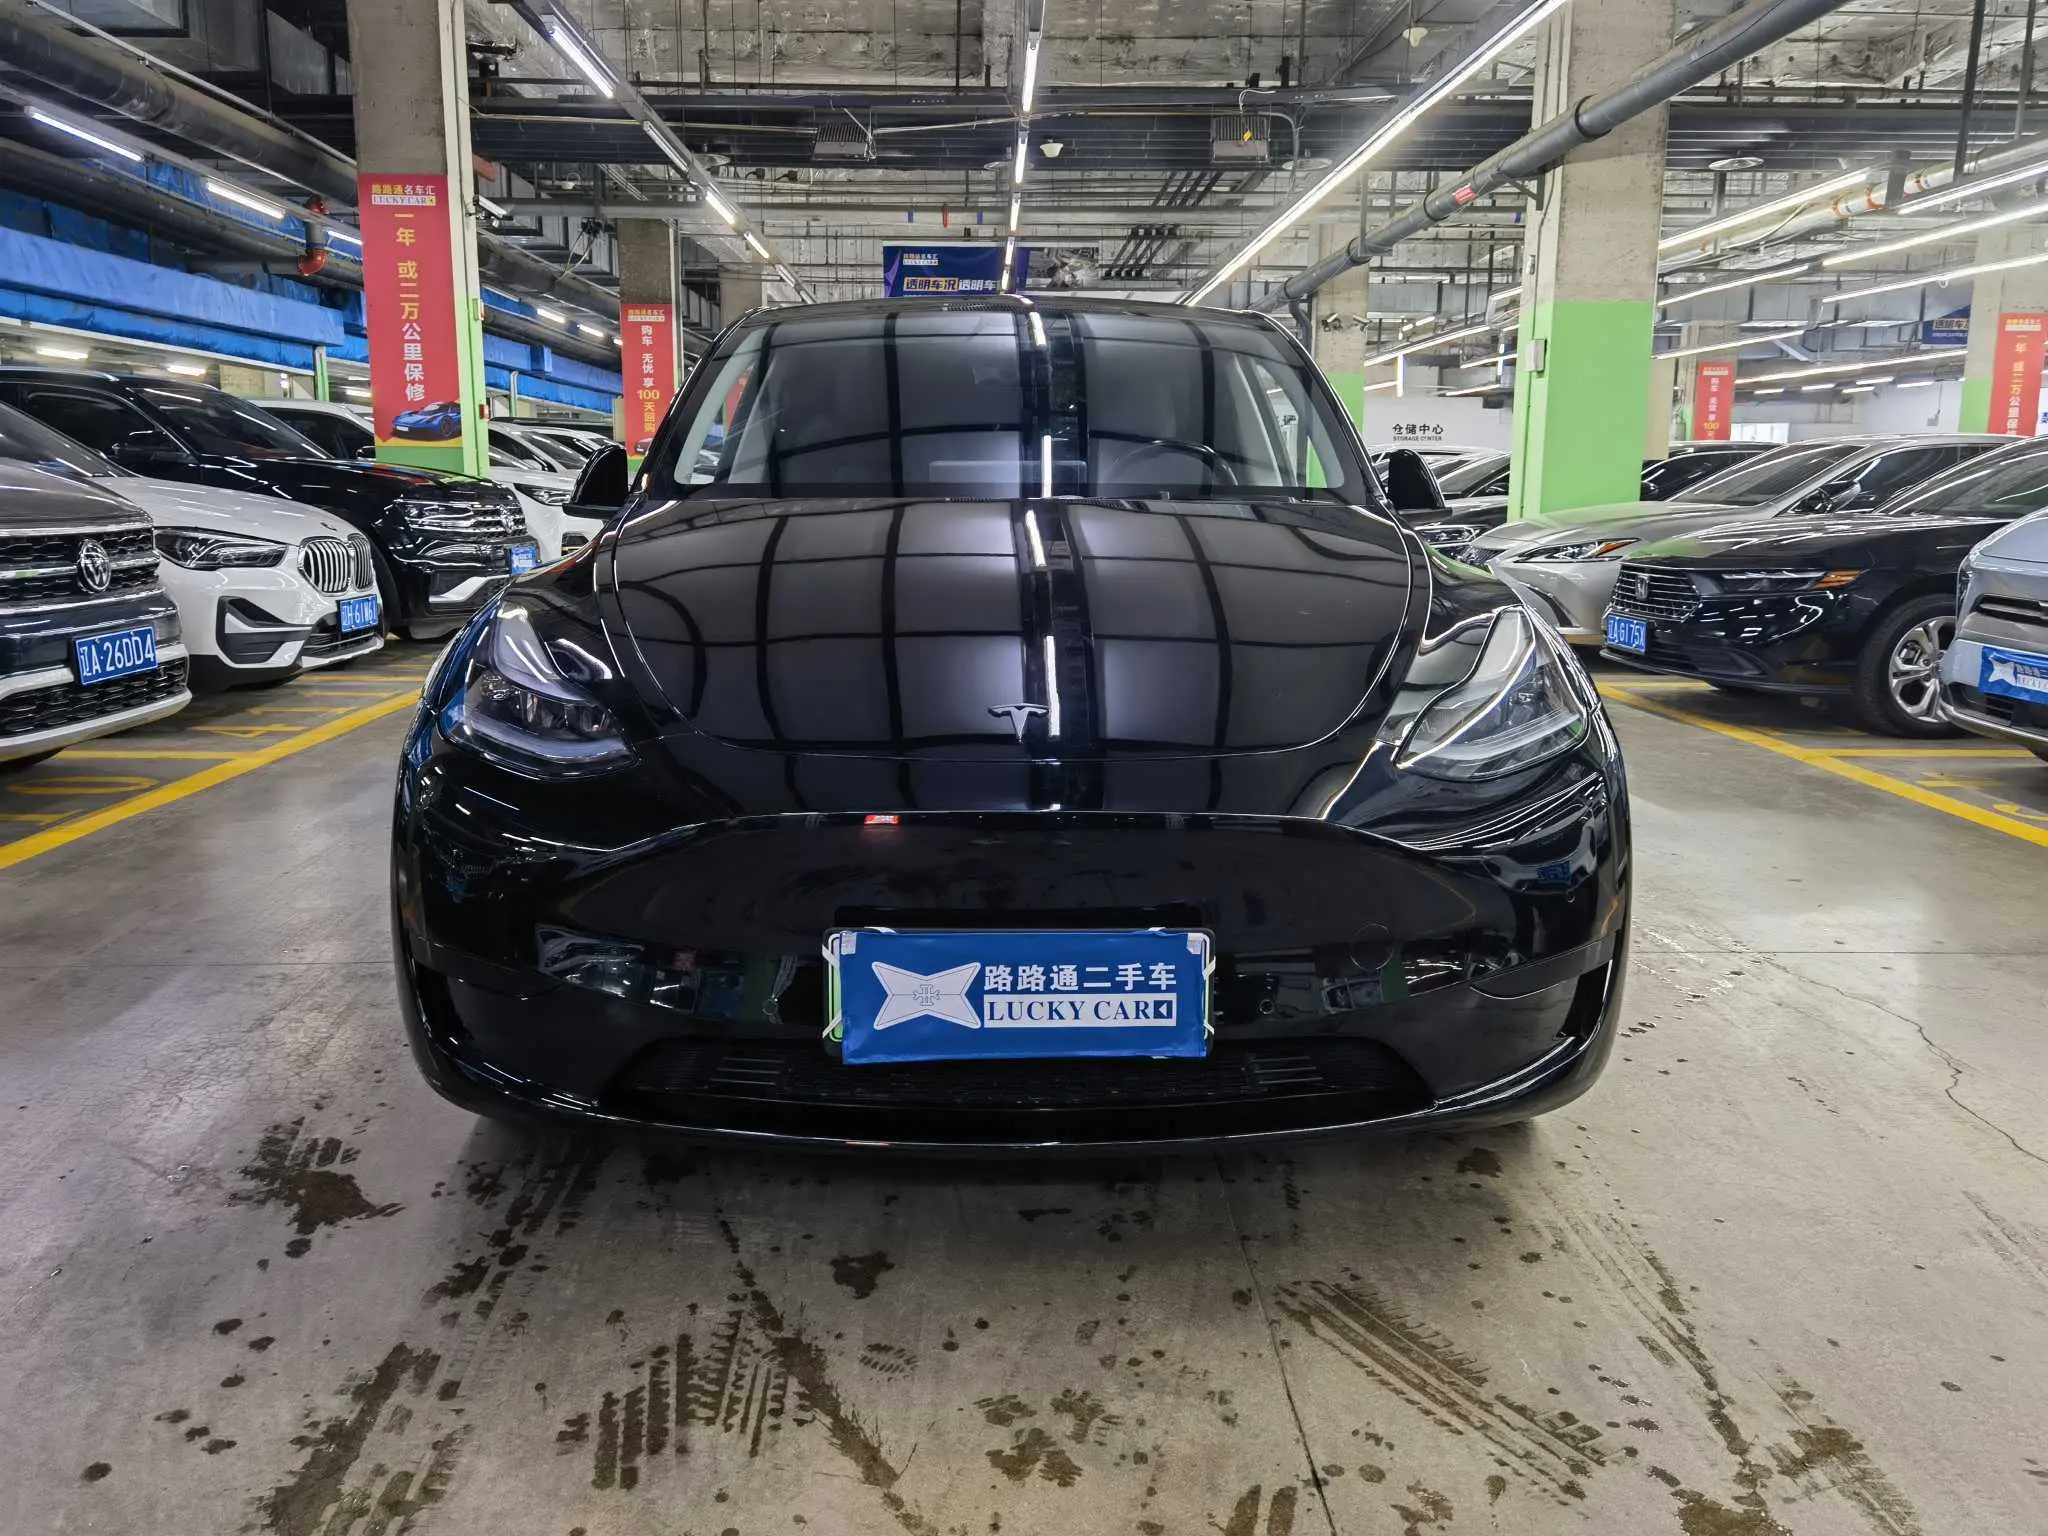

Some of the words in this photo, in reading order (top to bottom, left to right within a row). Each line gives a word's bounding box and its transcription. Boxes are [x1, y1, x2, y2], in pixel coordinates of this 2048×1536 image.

[1392, 423, 1444, 435] 仓储中心
[984, 963, 1177, 992] 路路通二手车
[986, 1000, 1084, 1021] LUCKY
[1093, 999, 1152, 1020] CAR
